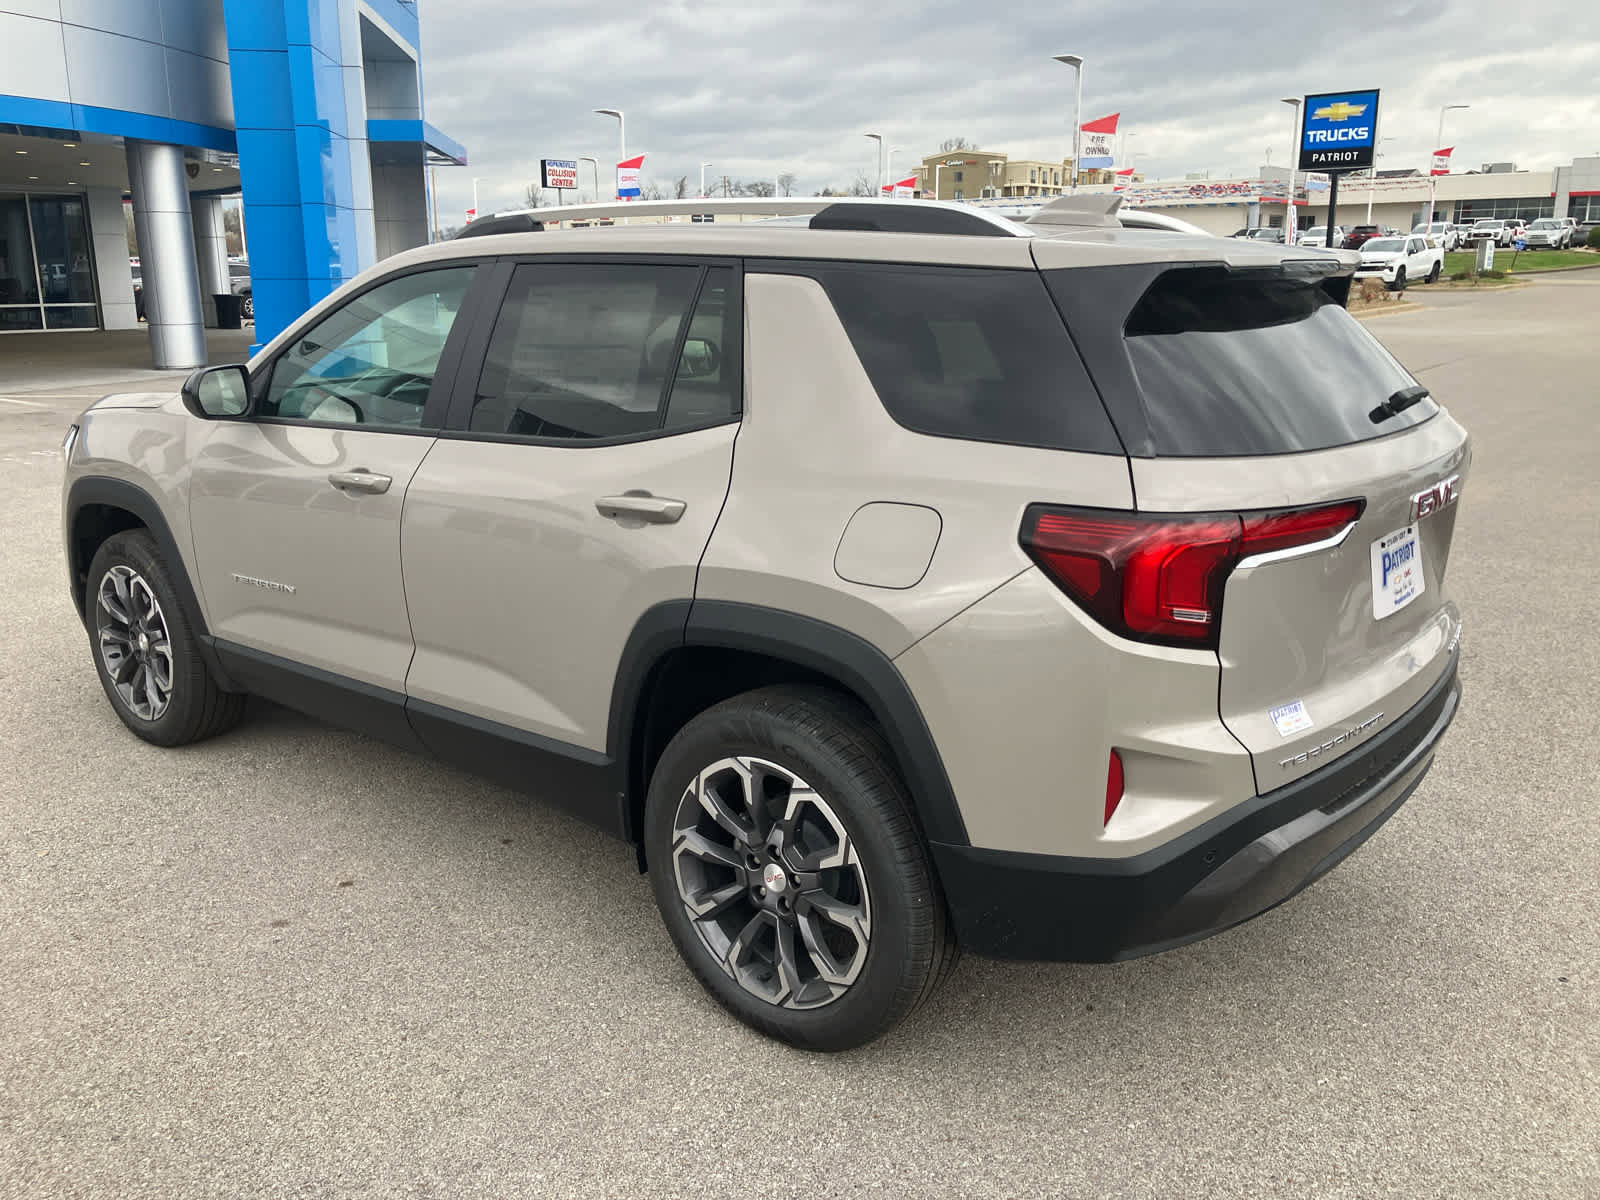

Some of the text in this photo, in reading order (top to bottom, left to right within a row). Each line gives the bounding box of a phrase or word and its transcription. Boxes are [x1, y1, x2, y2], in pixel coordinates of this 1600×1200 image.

[1091, 135, 1105, 144] PRE
[1307, 127, 1369, 143] TRUCKS
[1312, 151, 1359, 162] PATRIOT
[547, 168, 576, 178] COLLISION
[551, 178, 574, 187] CENTER
[1410, 475, 1460, 520] GMC
[1382, 541, 1416, 589] PATRIOT
